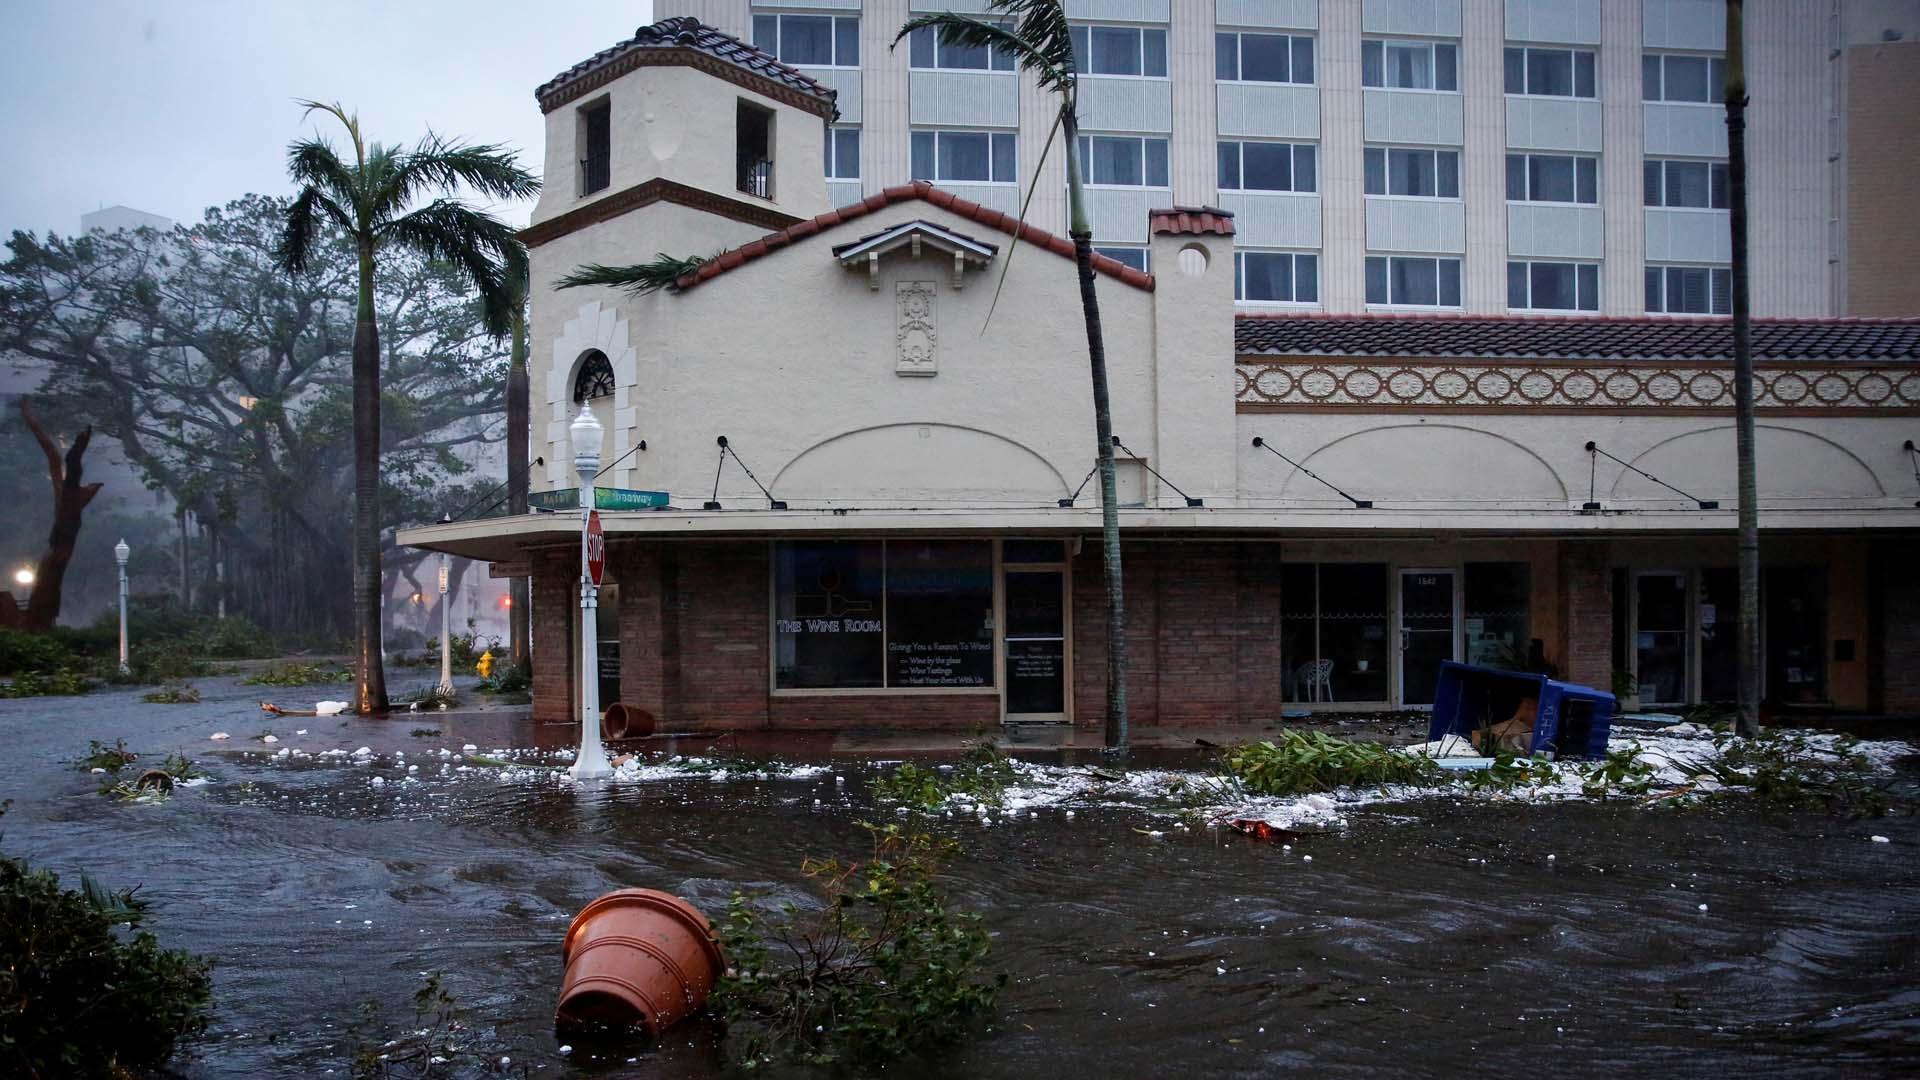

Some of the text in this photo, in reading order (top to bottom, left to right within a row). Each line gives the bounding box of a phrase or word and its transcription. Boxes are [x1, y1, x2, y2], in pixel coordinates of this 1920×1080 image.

[588, 533, 602, 561] STOP
[777, 619, 882, 633] THE WINE ROOM
[909, 656, 926, 664] Wine
[926, 656, 935, 666] by
[935, 656, 945, 664] the
